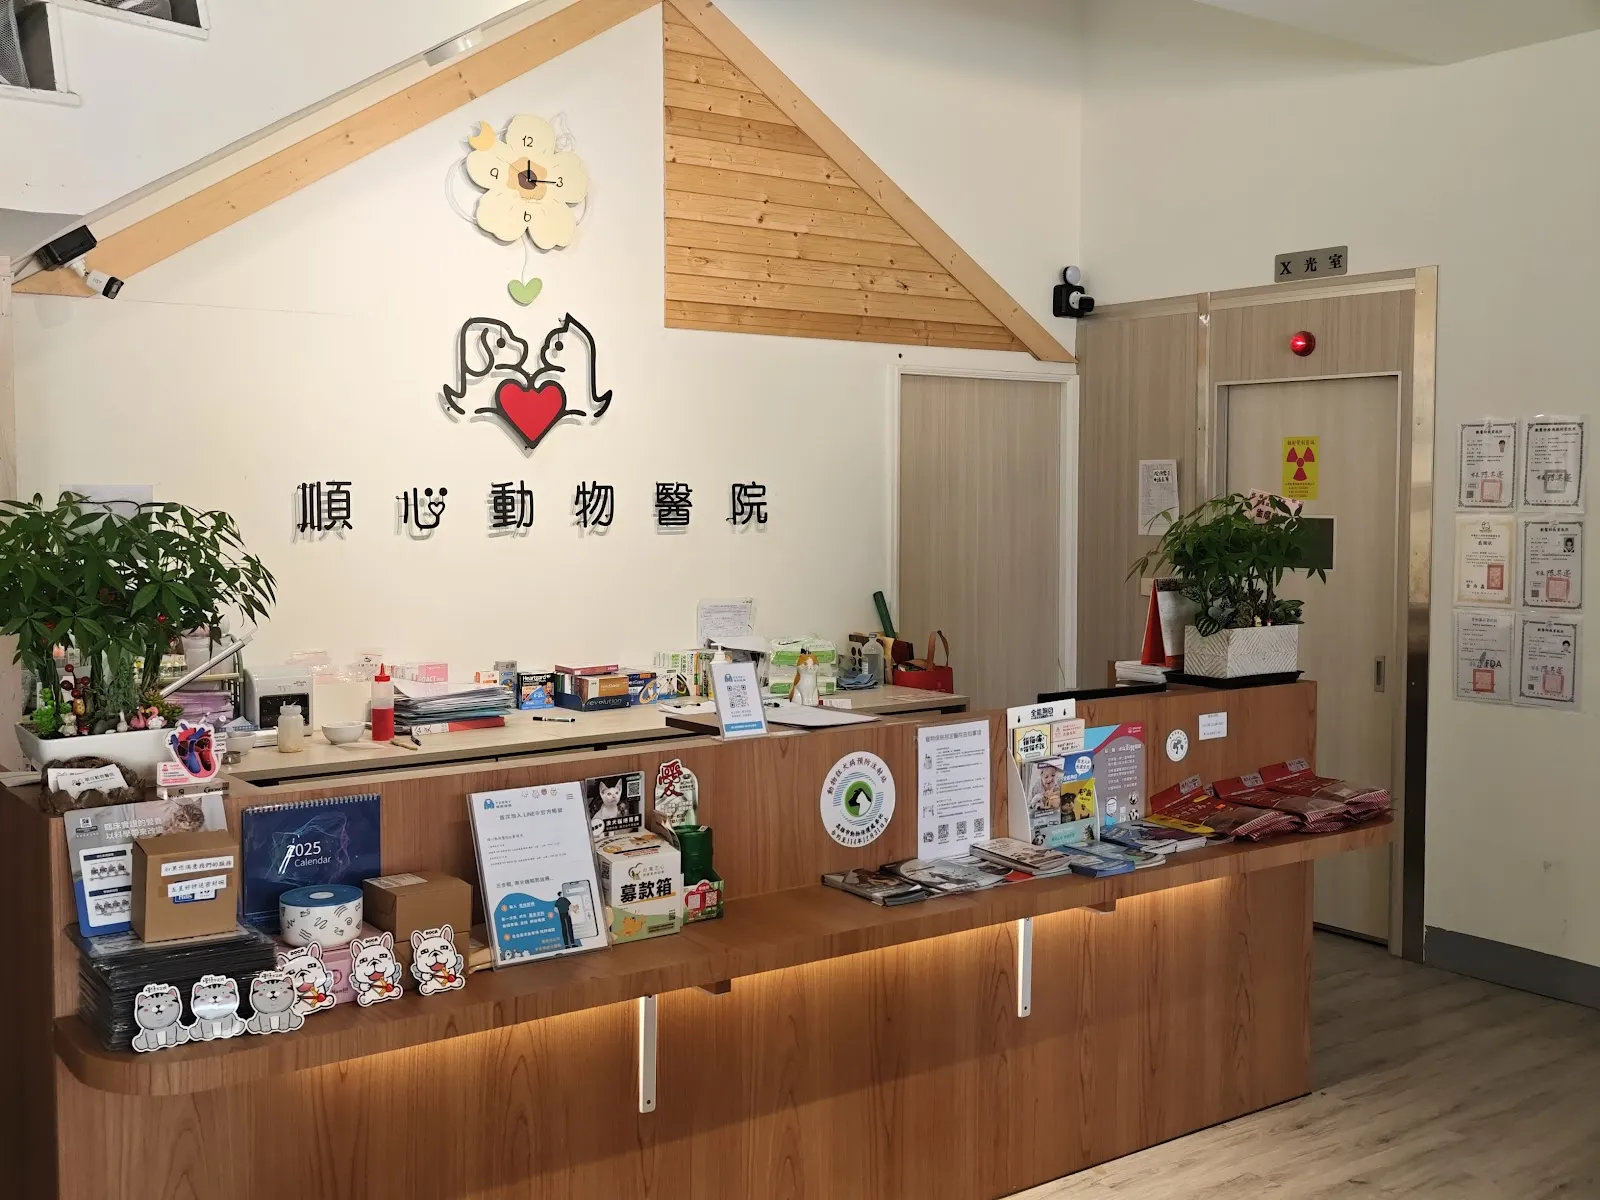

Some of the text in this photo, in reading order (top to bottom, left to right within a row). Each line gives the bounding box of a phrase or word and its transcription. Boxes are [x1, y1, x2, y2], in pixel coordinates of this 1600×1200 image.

[521, 135, 534, 148] 12
[555, 176, 565, 189] 3
[1279, 253, 1344, 276] X光室
[296, 479, 769, 532] 順心動物醫院
[287, 840, 322, 858] 2025
[164, 859, 232, 873] 如果您滿意我們的服務
[294, 855, 332, 868] Calendar
[620, 877, 673, 904] 募款箱
